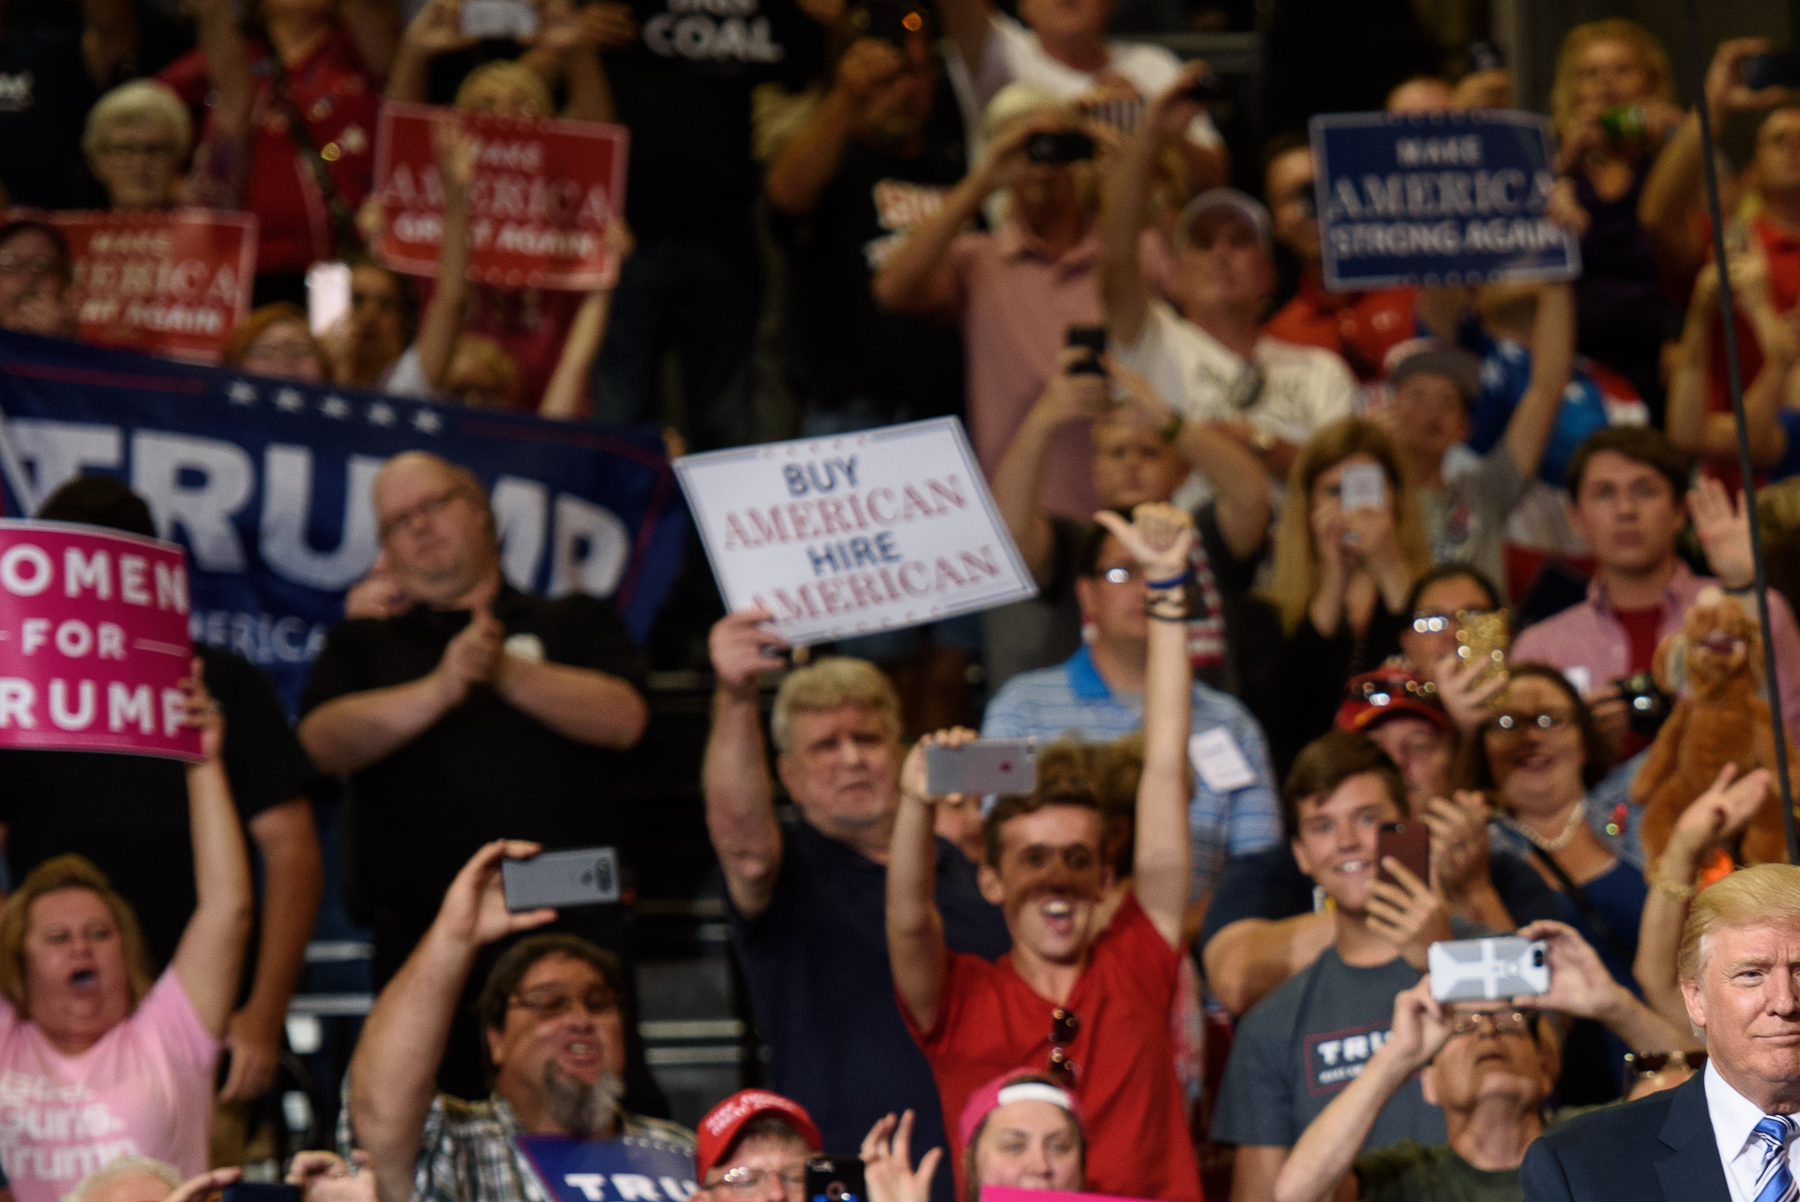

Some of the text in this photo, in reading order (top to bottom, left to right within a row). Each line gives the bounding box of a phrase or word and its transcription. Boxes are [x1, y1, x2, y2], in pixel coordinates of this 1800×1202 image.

[643, 14, 785, 62] COAL
[1397, 133, 1482, 166] MAKE
[1330, 219, 1462, 258] STRONG
[783, 454, 861, 498] BUY
[724, 473, 967, 550] AMERICAN
[806, 531, 903, 576] HIRE
[0, 544, 188, 616] OMEN
[21, 617, 126, 661] FOR
[0, 678, 188, 738] RUMP
